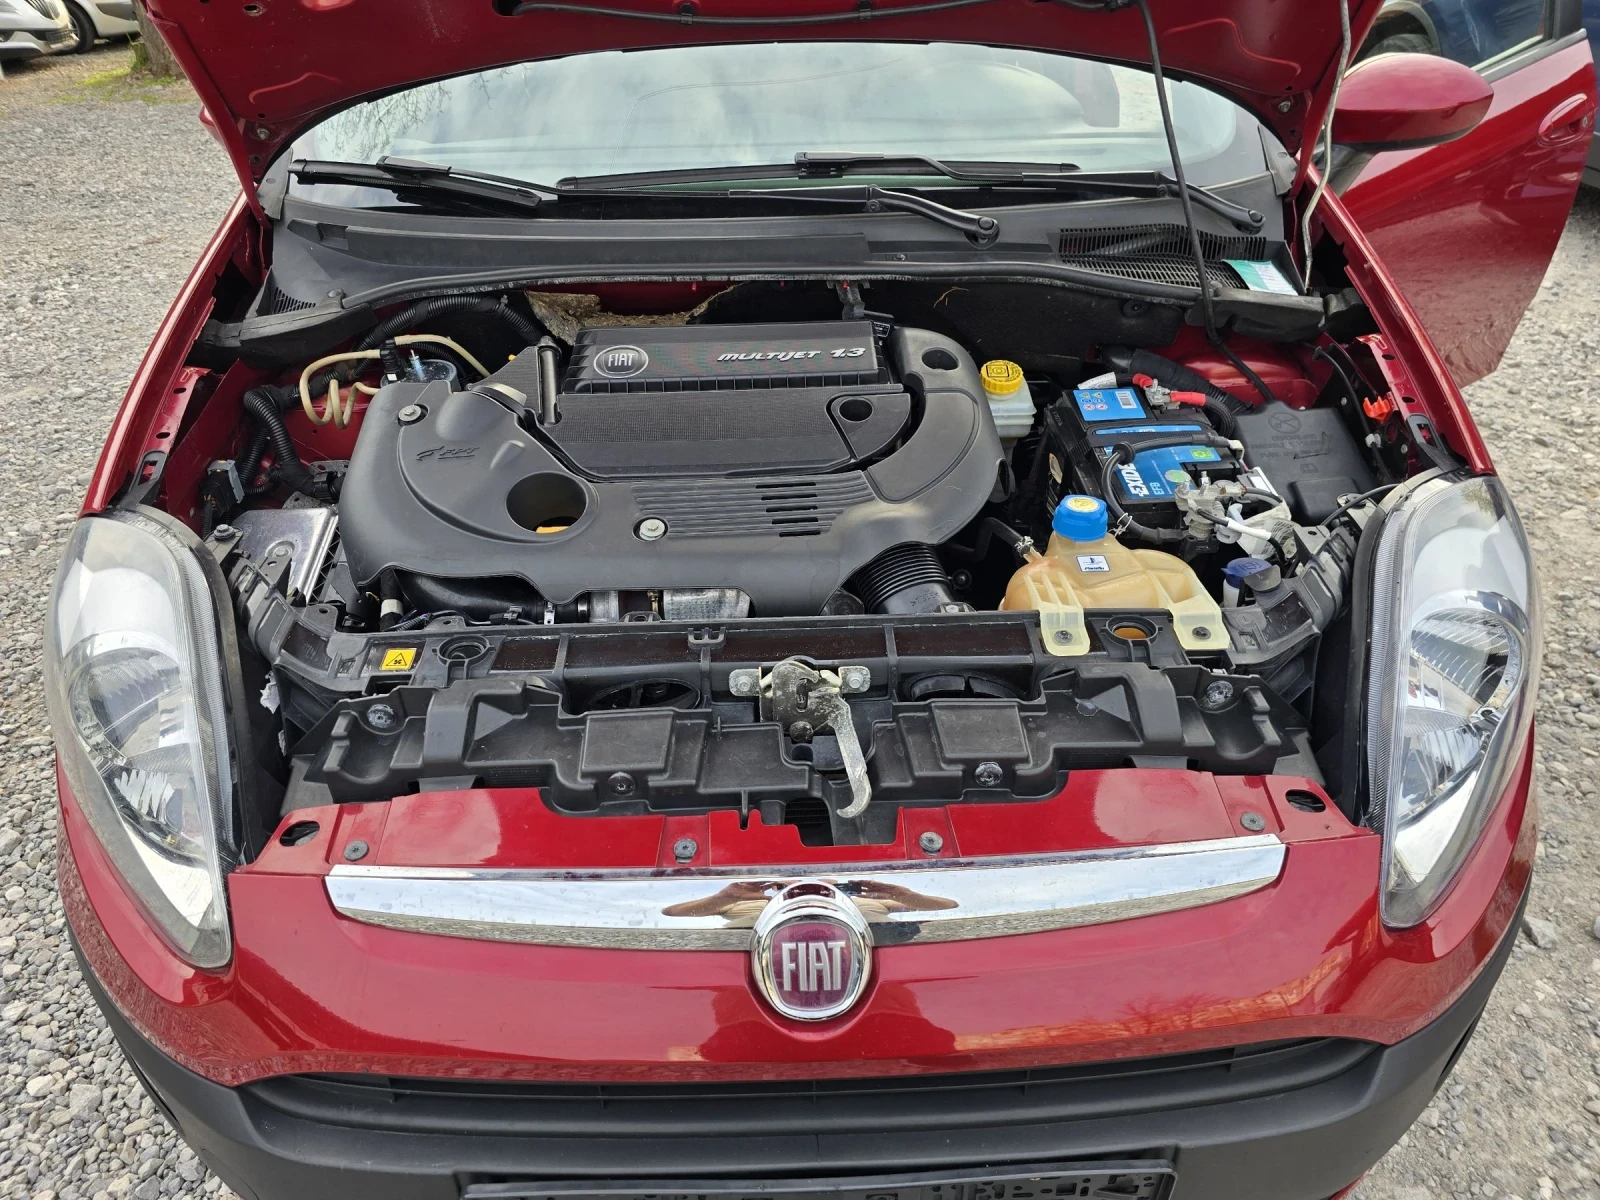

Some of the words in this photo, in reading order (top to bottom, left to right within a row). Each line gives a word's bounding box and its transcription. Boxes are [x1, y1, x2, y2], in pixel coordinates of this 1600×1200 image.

[608, 352, 635, 366] FIAT
[829, 347, 866, 358] 1.3
[1149, 482, 1165, 495] EFB
[781, 941, 846, 992] FIAT
